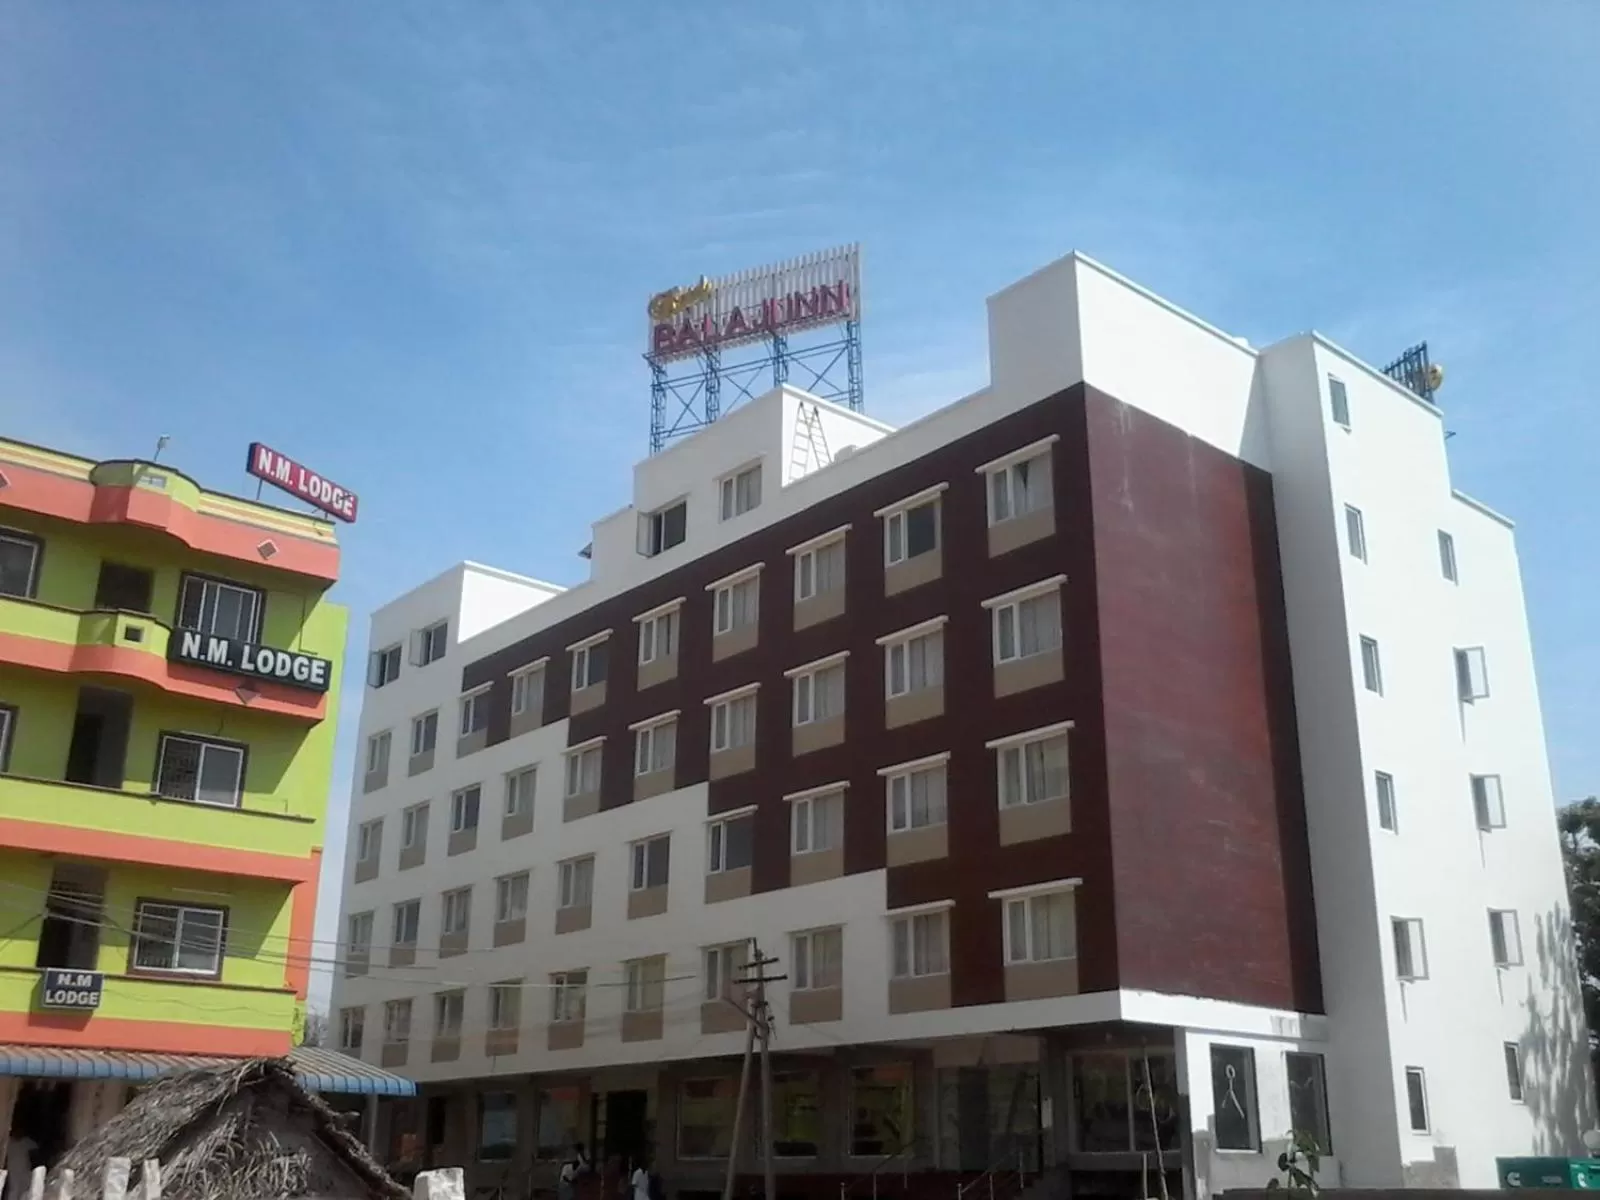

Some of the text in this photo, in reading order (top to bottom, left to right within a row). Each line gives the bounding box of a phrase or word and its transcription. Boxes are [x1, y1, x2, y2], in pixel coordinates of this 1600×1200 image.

[786, 279, 850, 324] INN
[259, 447, 353, 516] N.M. LODGE
[181, 631, 326, 684] N.M. LODGE
[45, 989, 99, 1005] LODGE
[57, 973, 92, 987] N.M
